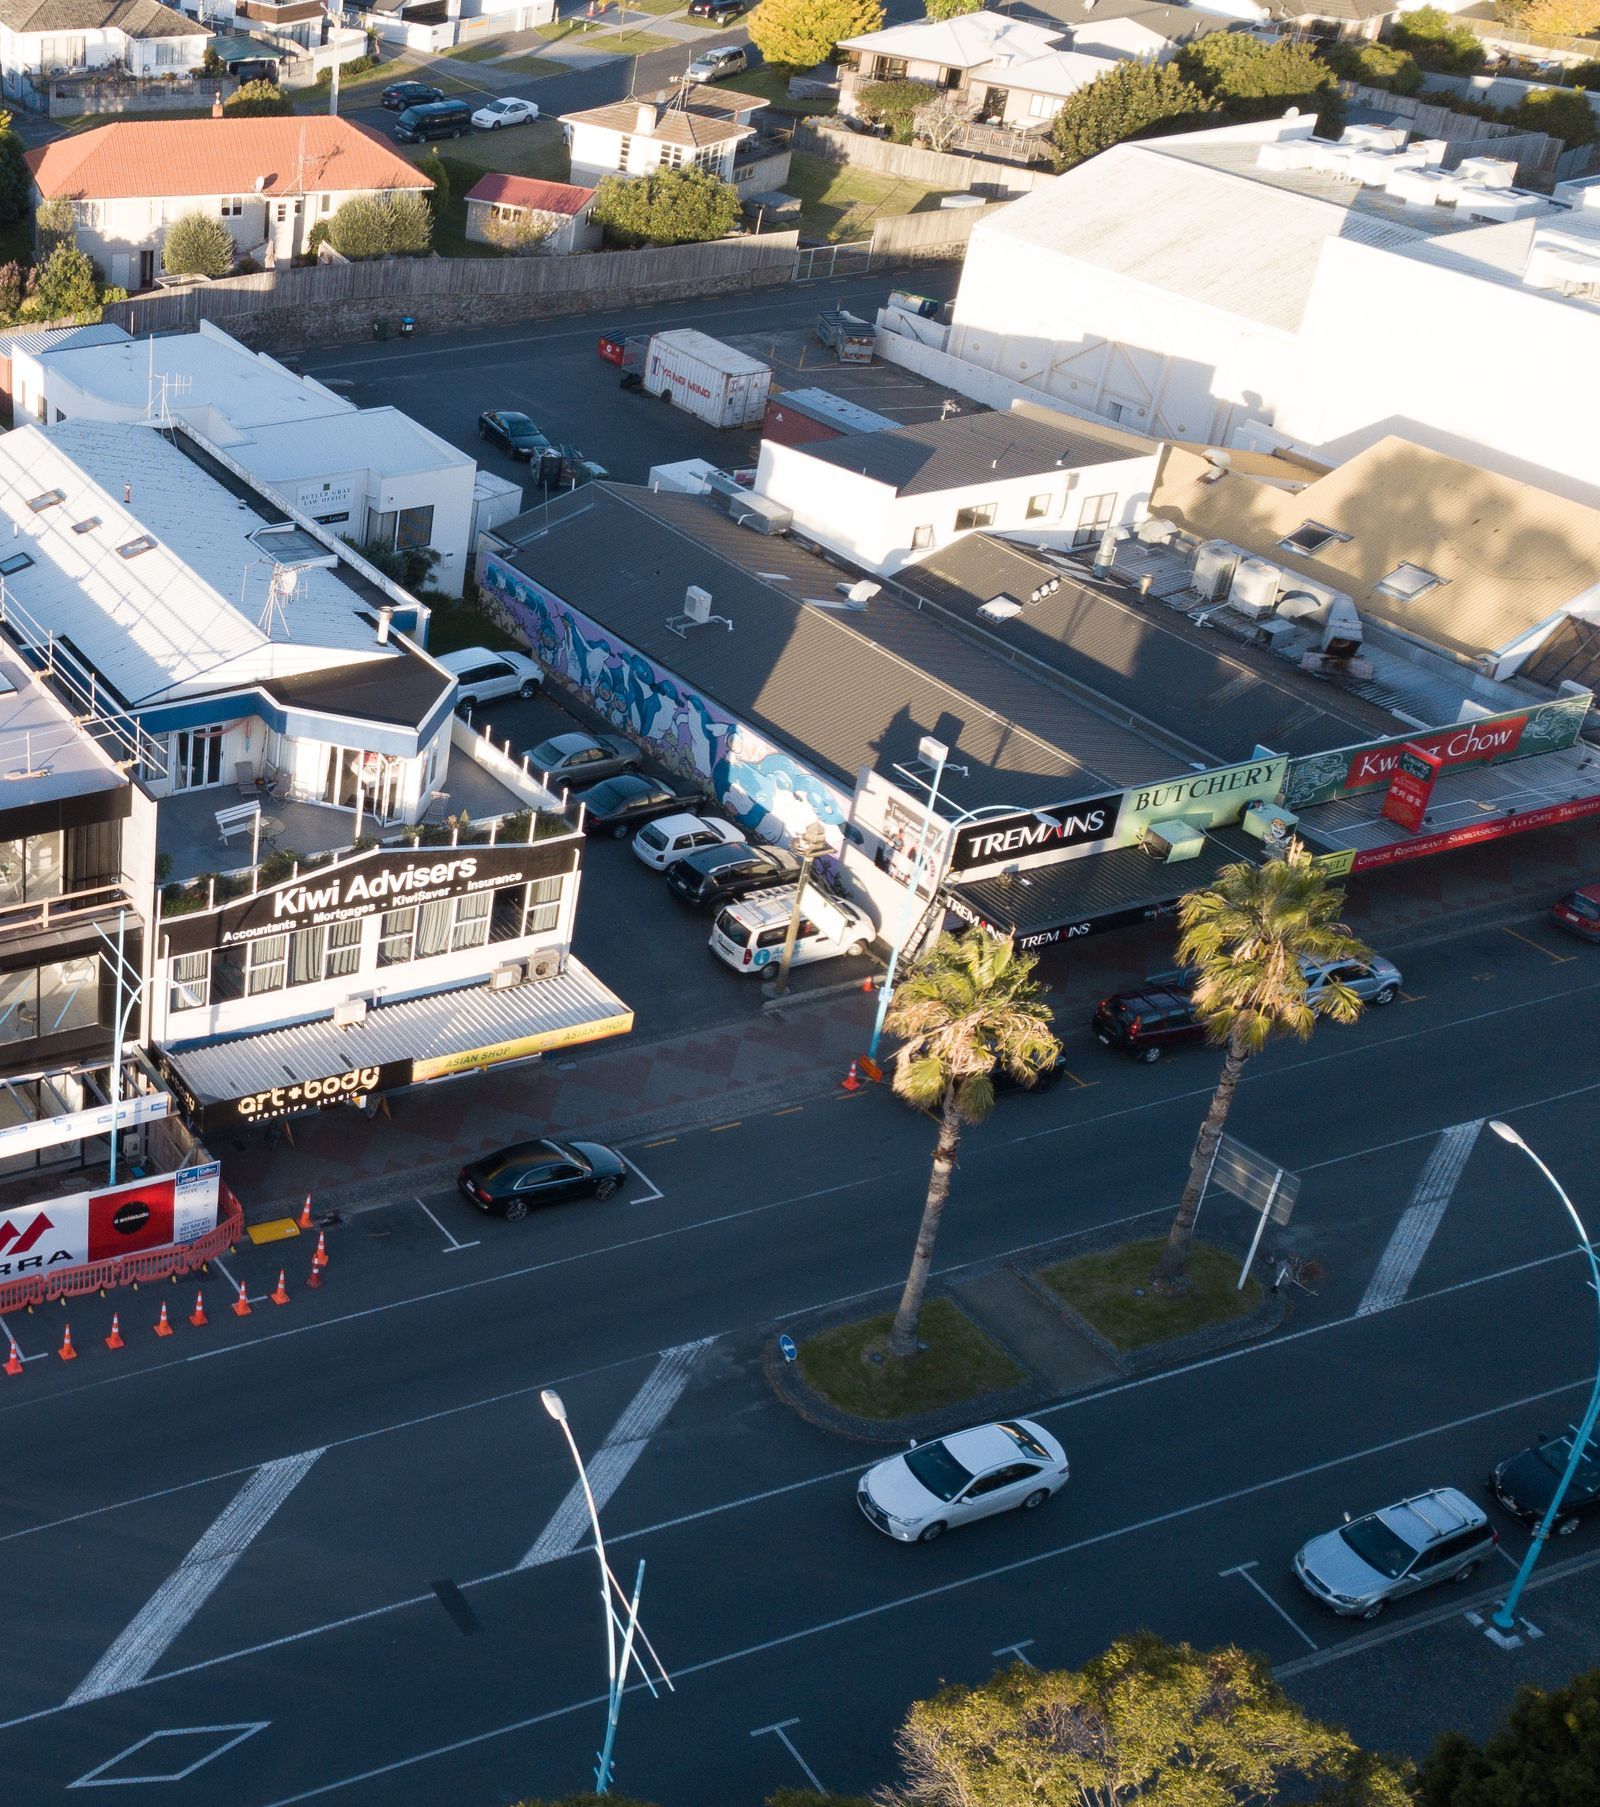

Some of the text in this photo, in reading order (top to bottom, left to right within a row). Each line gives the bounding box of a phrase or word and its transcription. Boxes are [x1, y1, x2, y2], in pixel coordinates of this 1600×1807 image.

[1447, 724, 1512, 757] Chow
[1134, 762, 1282, 812] BUTCHERY
[968, 810, 1105, 858] TREMAINS
[274, 857, 478, 918] Kiwi Advisers
[222, 871, 523, 943] Accountants Mortgages KiwiSaver Insurance
[1020, 923, 1092, 949] TREMAINS
[563, 1026, 597, 1041] ASIAN
[598, 1019, 628, 1033] SHOP
[444, 1053, 479, 1069] ASIAN
[480, 1046, 511, 1061] SHOP
[177, 1170, 189, 1179] For
[178, 1176, 196, 1186] Lease
